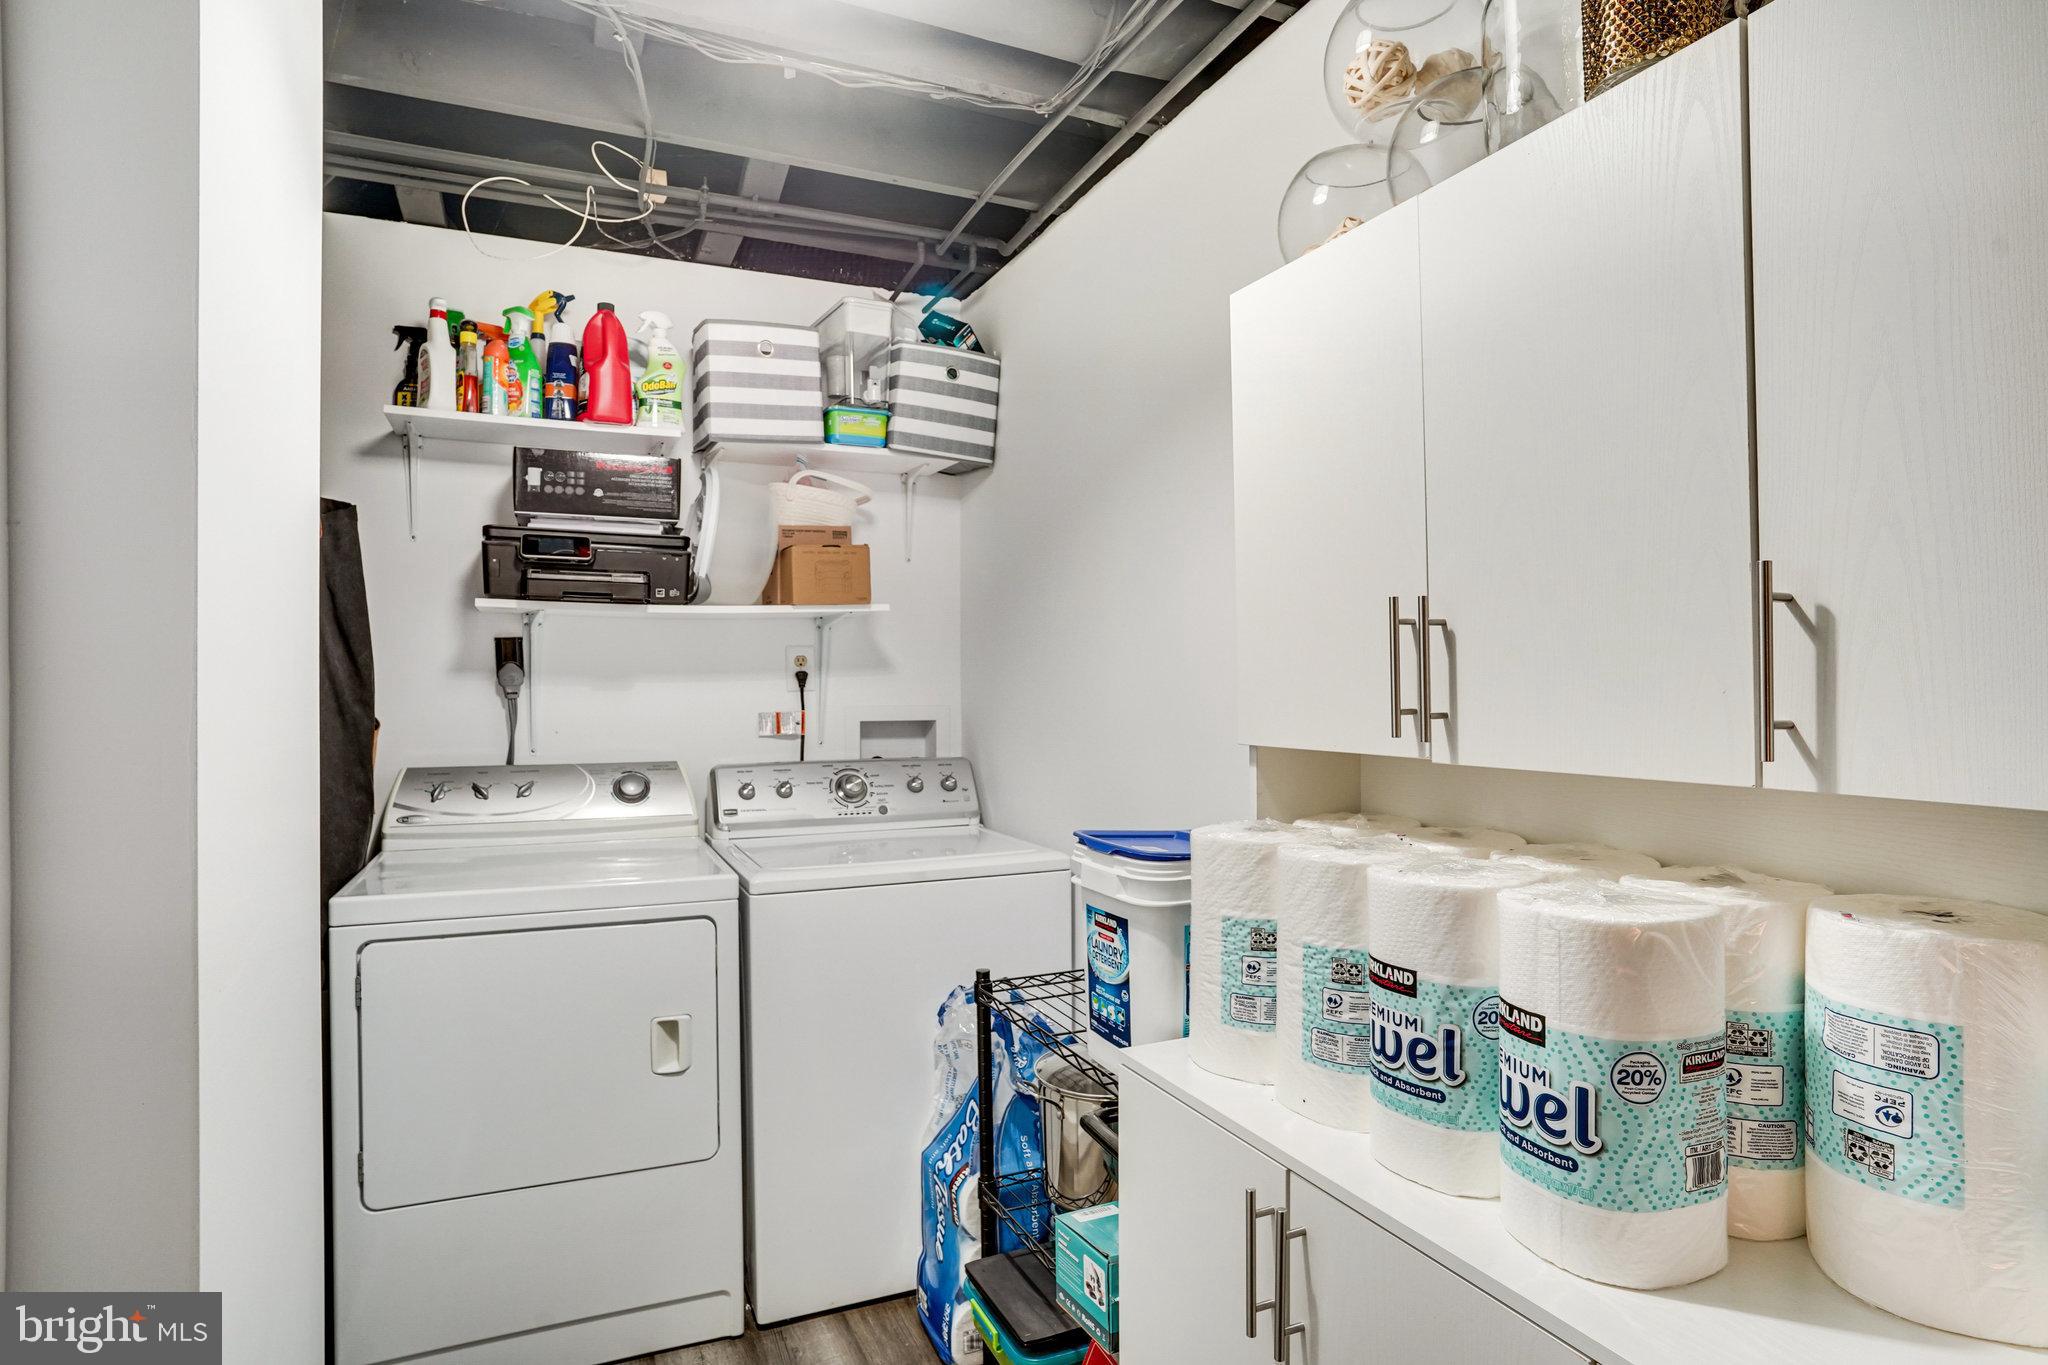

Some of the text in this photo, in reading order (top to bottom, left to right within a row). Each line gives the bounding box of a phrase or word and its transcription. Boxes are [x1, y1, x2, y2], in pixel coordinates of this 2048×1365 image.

[1092, 937, 1124, 961] LAUNDRY
[1092, 949, 1123, 971] DETERGENT
[1372, 1001, 1418, 1032] EMIUM
[1478, 1011, 1499, 1025] 20
[1371, 1017, 1461, 1082] wel
[1881, 1055, 1903, 1064] DANGER
[1617, 1069, 1662, 1086] 20%
[1885, 1062, 1926, 1075] WARNING:
[1380, 1073, 1392, 1085] and
[1394, 1080, 1442, 1100] Absorbent
[1500, 1067, 1596, 1149] wel
[1874, 1094, 1905, 1108] PEFC
[1020, 1135, 1032, 1158] Soft
[1506, 1132, 1520, 1144] and
[1521, 1139, 1574, 1169] Absorbent
[933, 1099, 980, 1262] Bath Tissue
[951, 1167, 970, 1226] KIRKLAND
